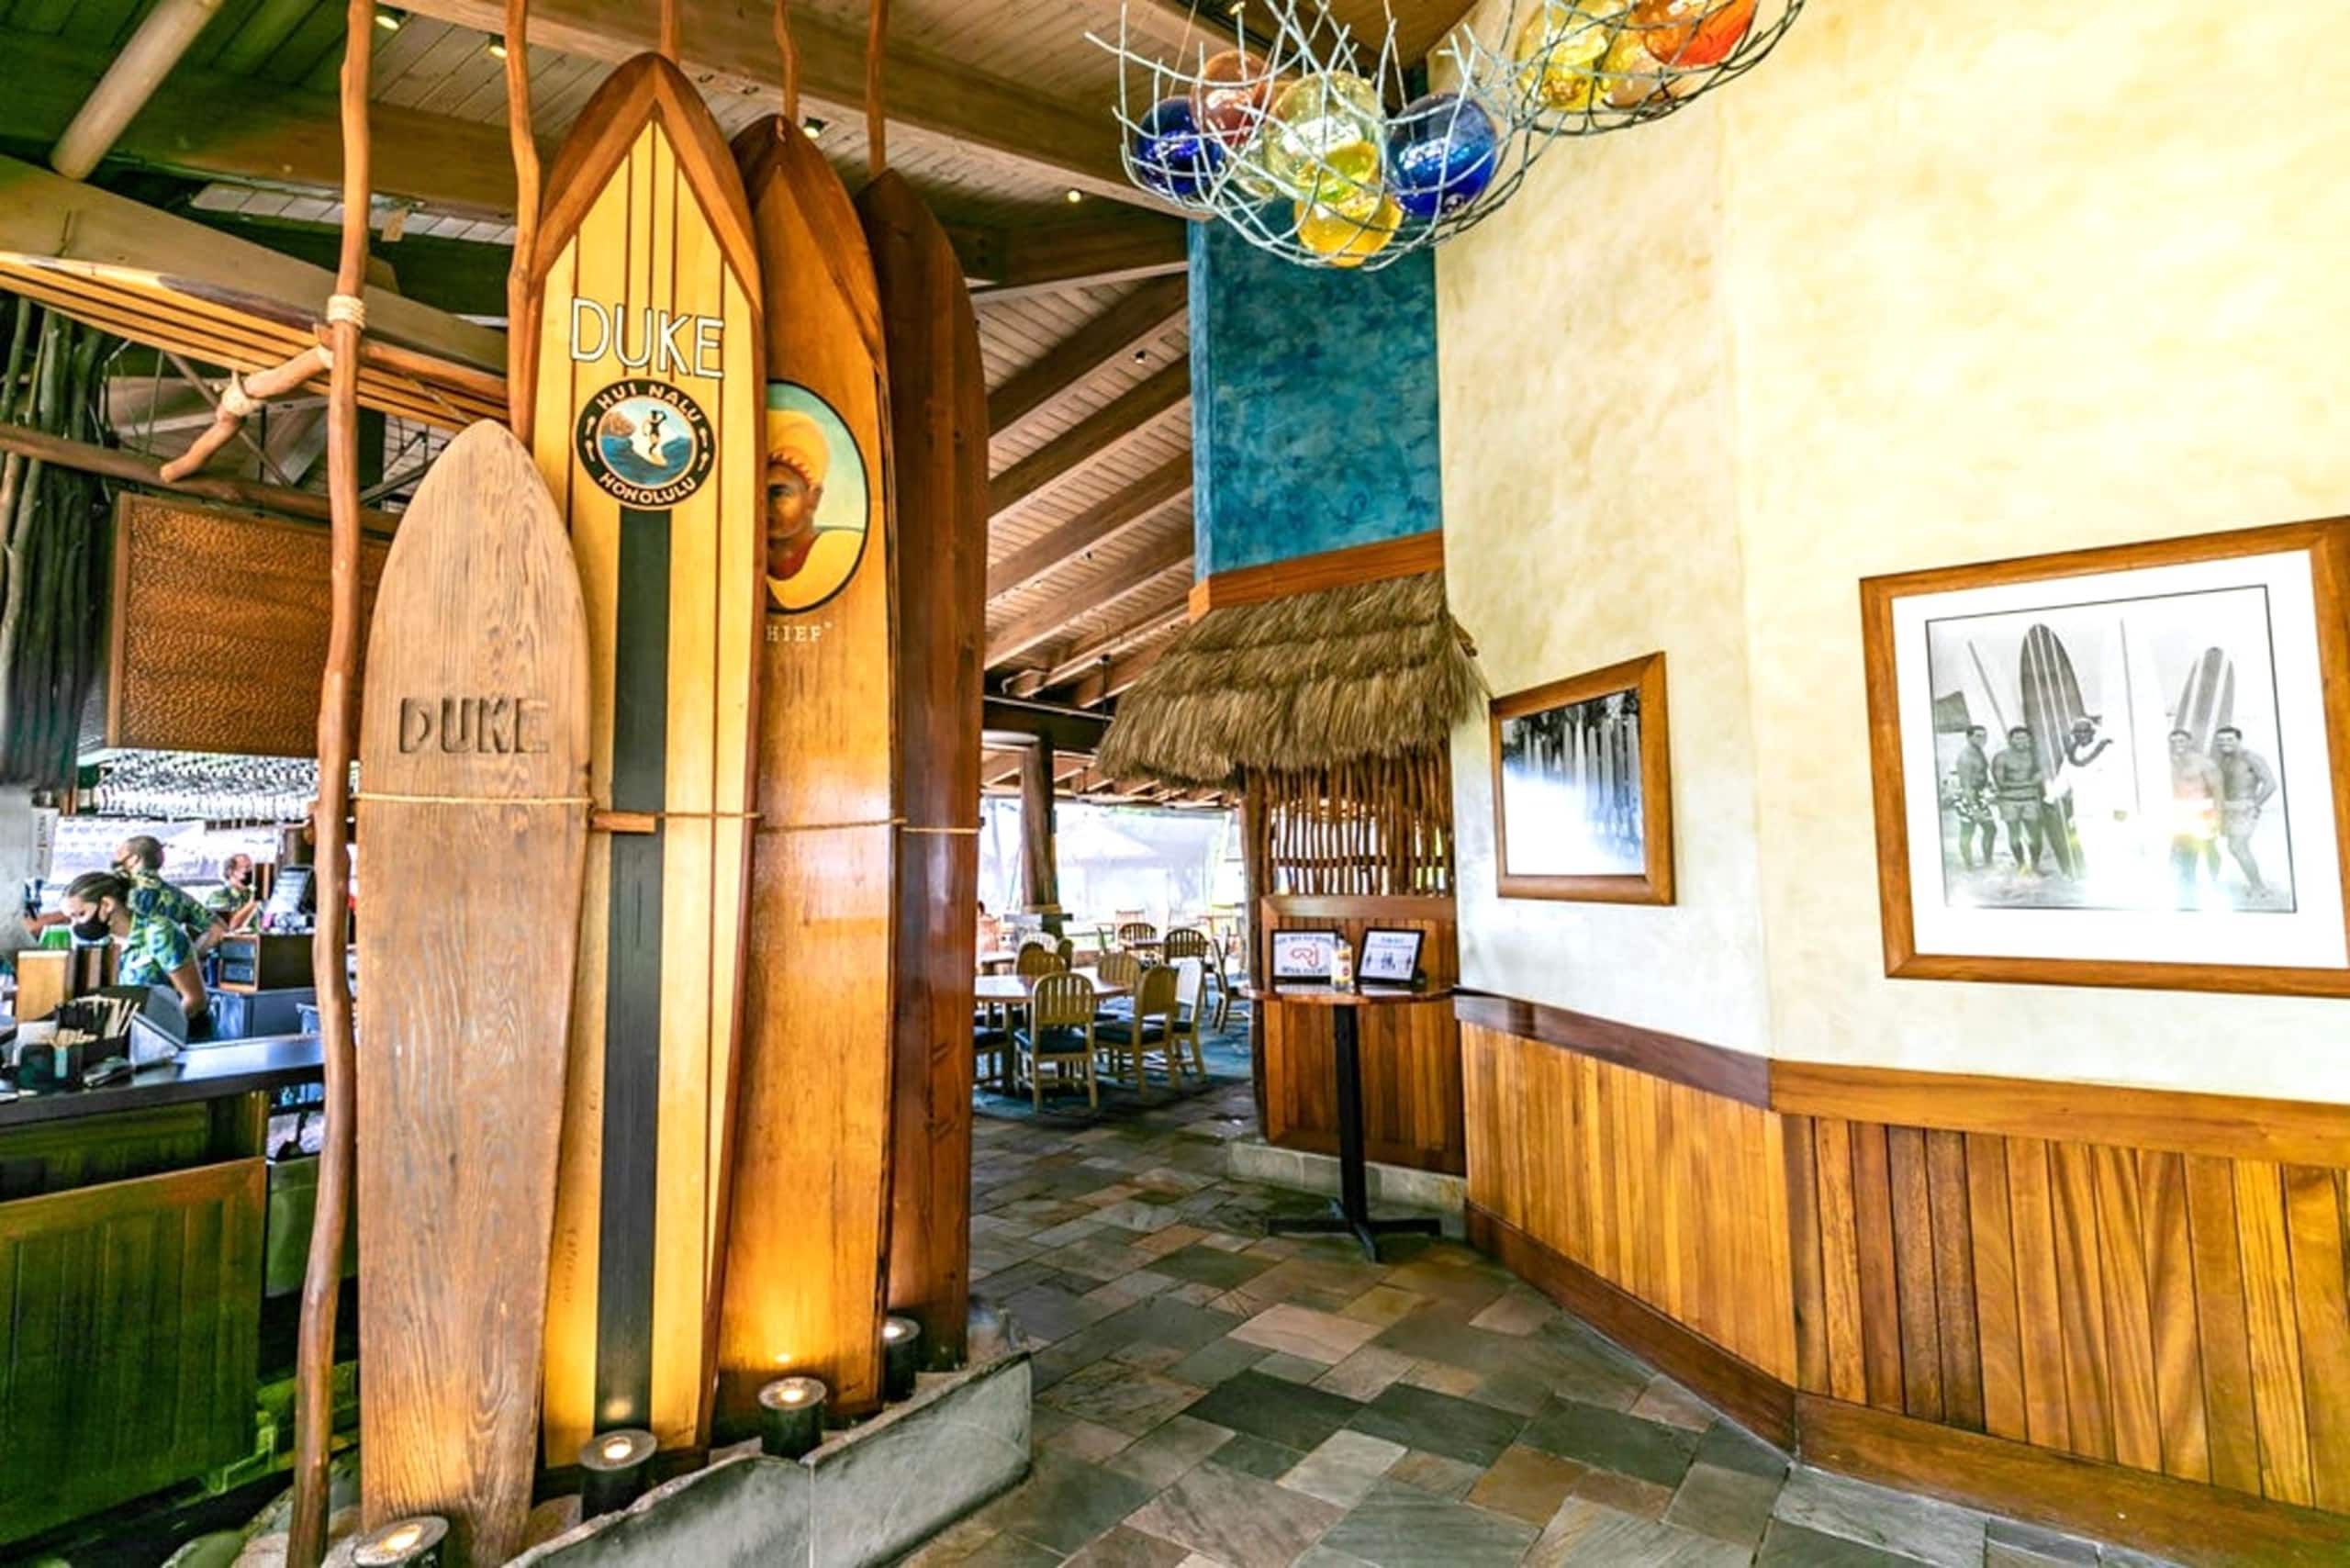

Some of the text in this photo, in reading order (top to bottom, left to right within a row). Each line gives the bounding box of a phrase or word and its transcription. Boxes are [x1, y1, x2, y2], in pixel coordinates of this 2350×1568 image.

[570, 297, 724, 379] DUKE
[596, 382, 702, 422] HUI NALU
[599, 472, 697, 505] HONOLULU
[766, 622, 834, 642] HIEF"
[397, 696, 551, 754] DUKE
